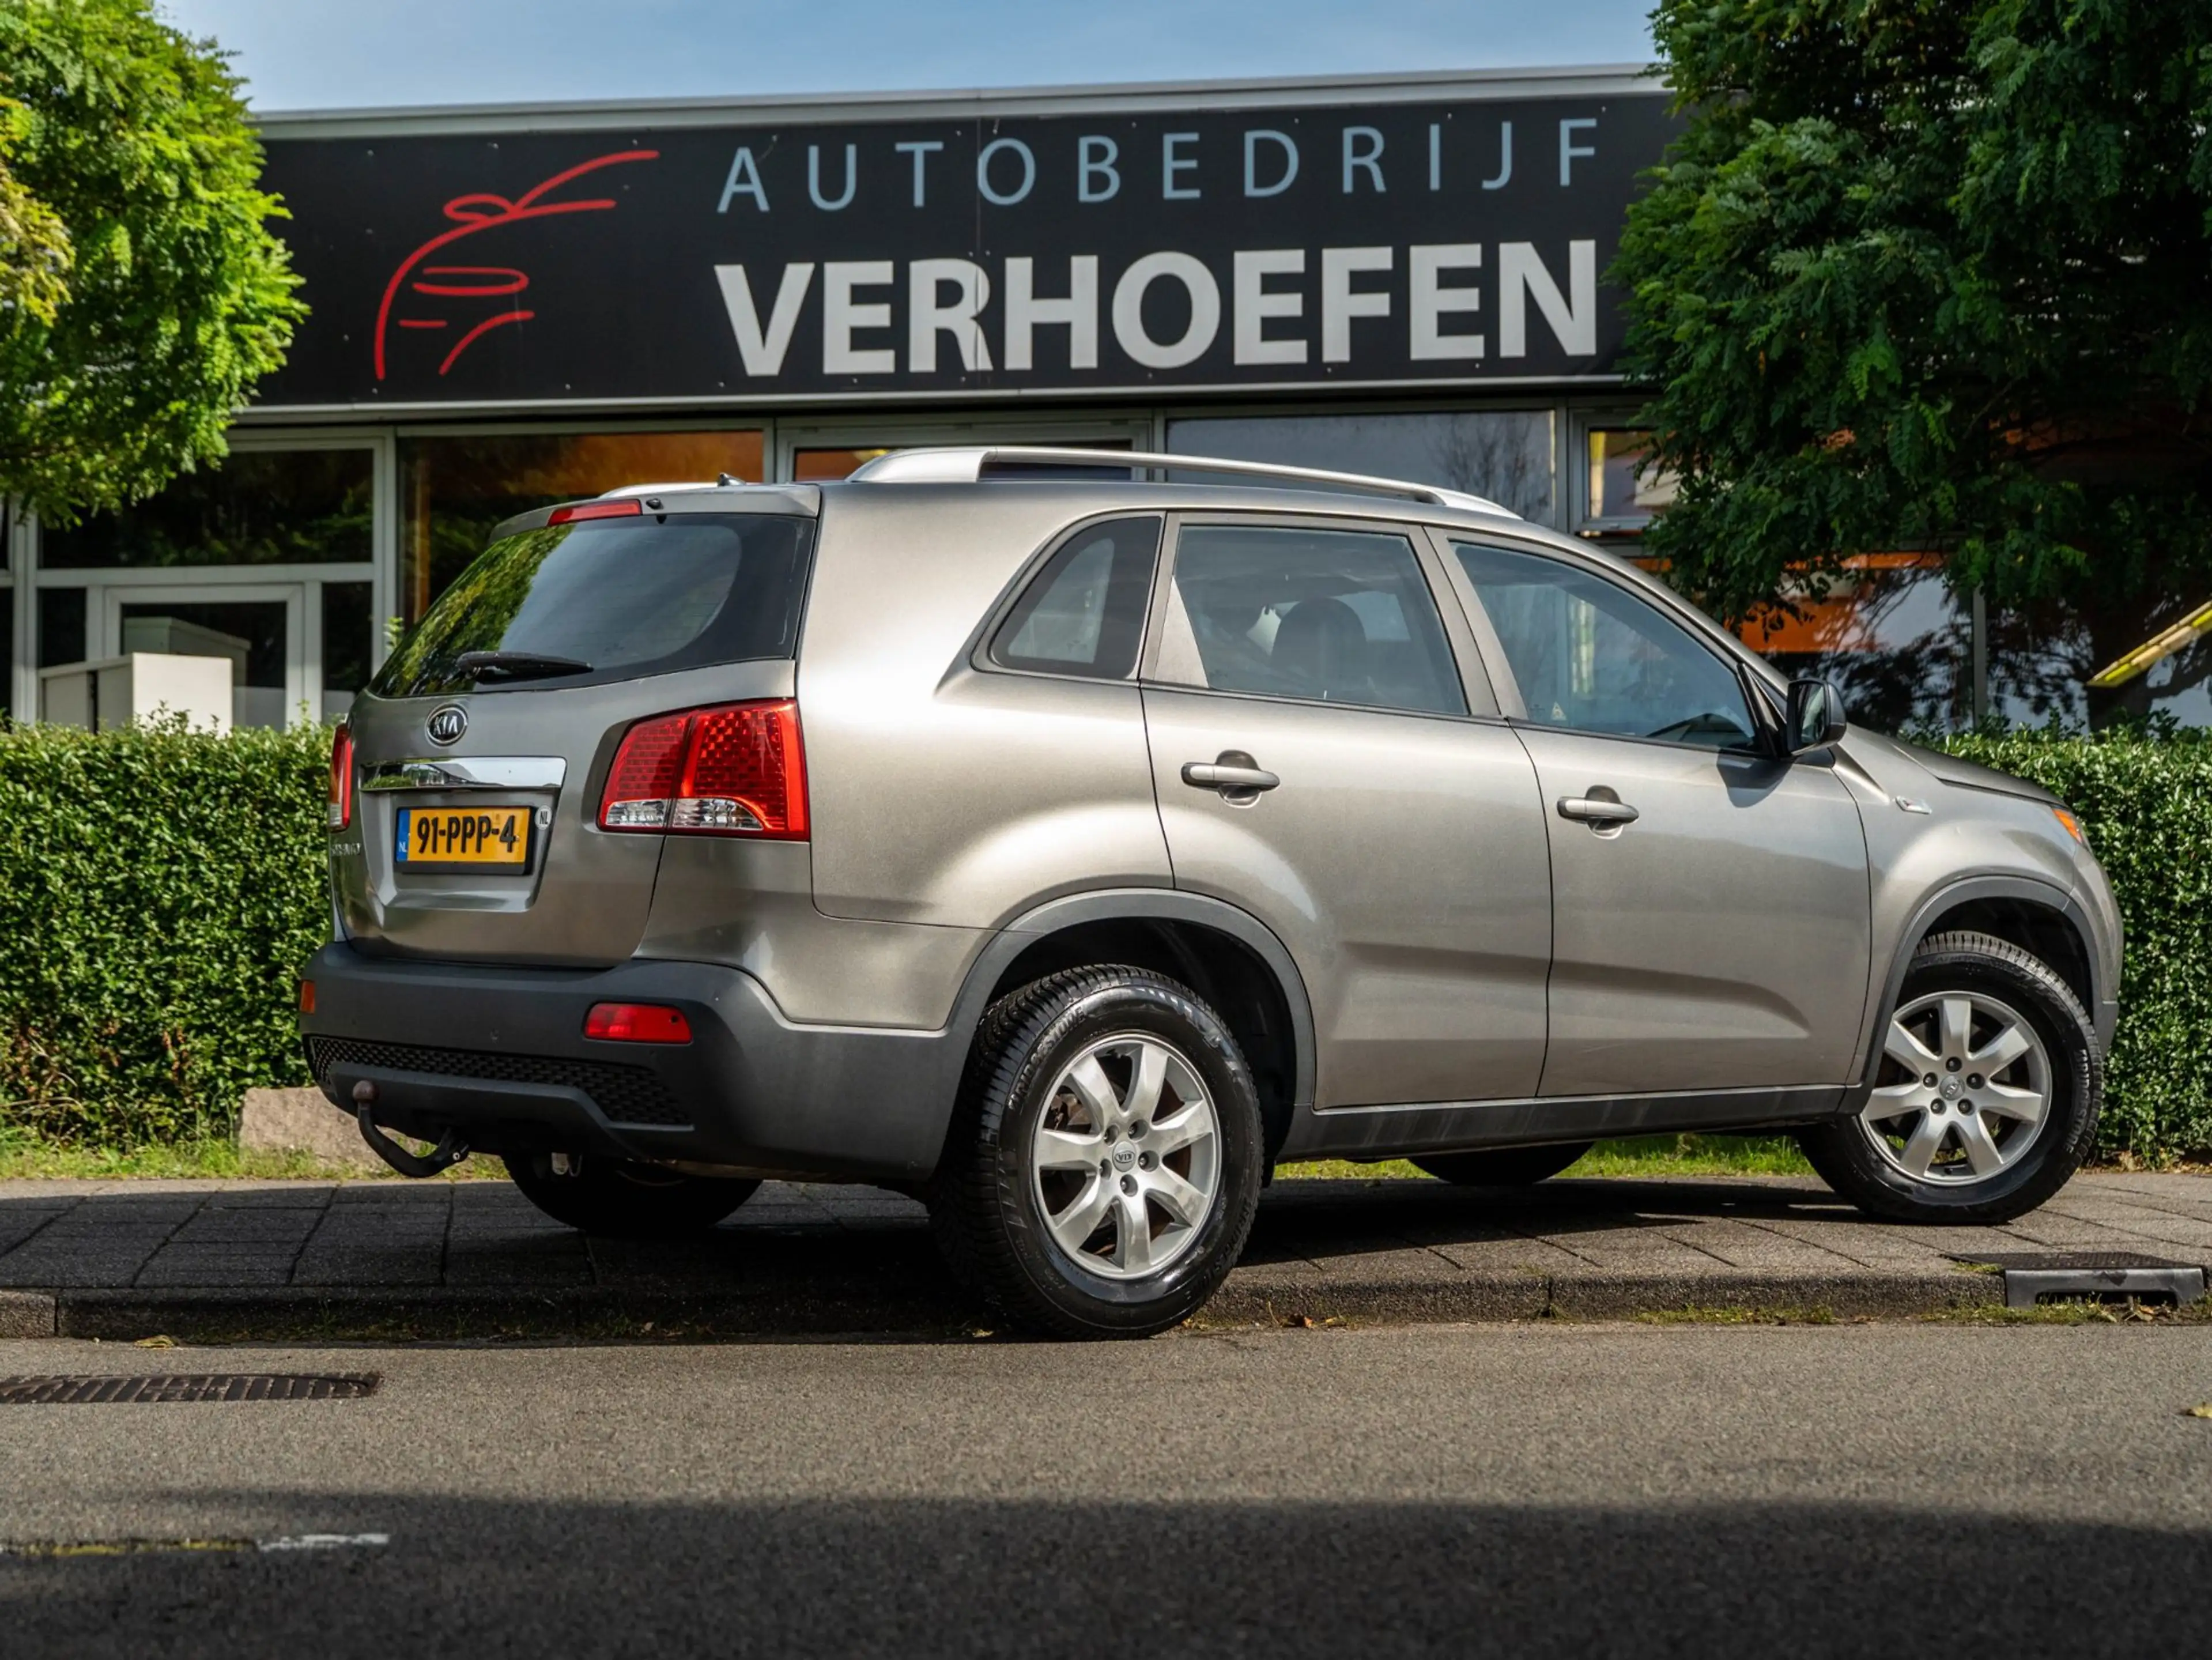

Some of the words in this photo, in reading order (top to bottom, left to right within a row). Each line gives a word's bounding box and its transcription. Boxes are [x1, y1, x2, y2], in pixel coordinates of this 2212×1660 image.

[716, 118, 1598, 213] AUTOBEDRIJF
[714, 239, 1596, 376] VERHOEFEN
[433, 715, 458, 735] KIA
[539, 810, 549, 825] NL
[398, 841, 407, 852] NL
[417, 814, 516, 854] 91-PPP-4
